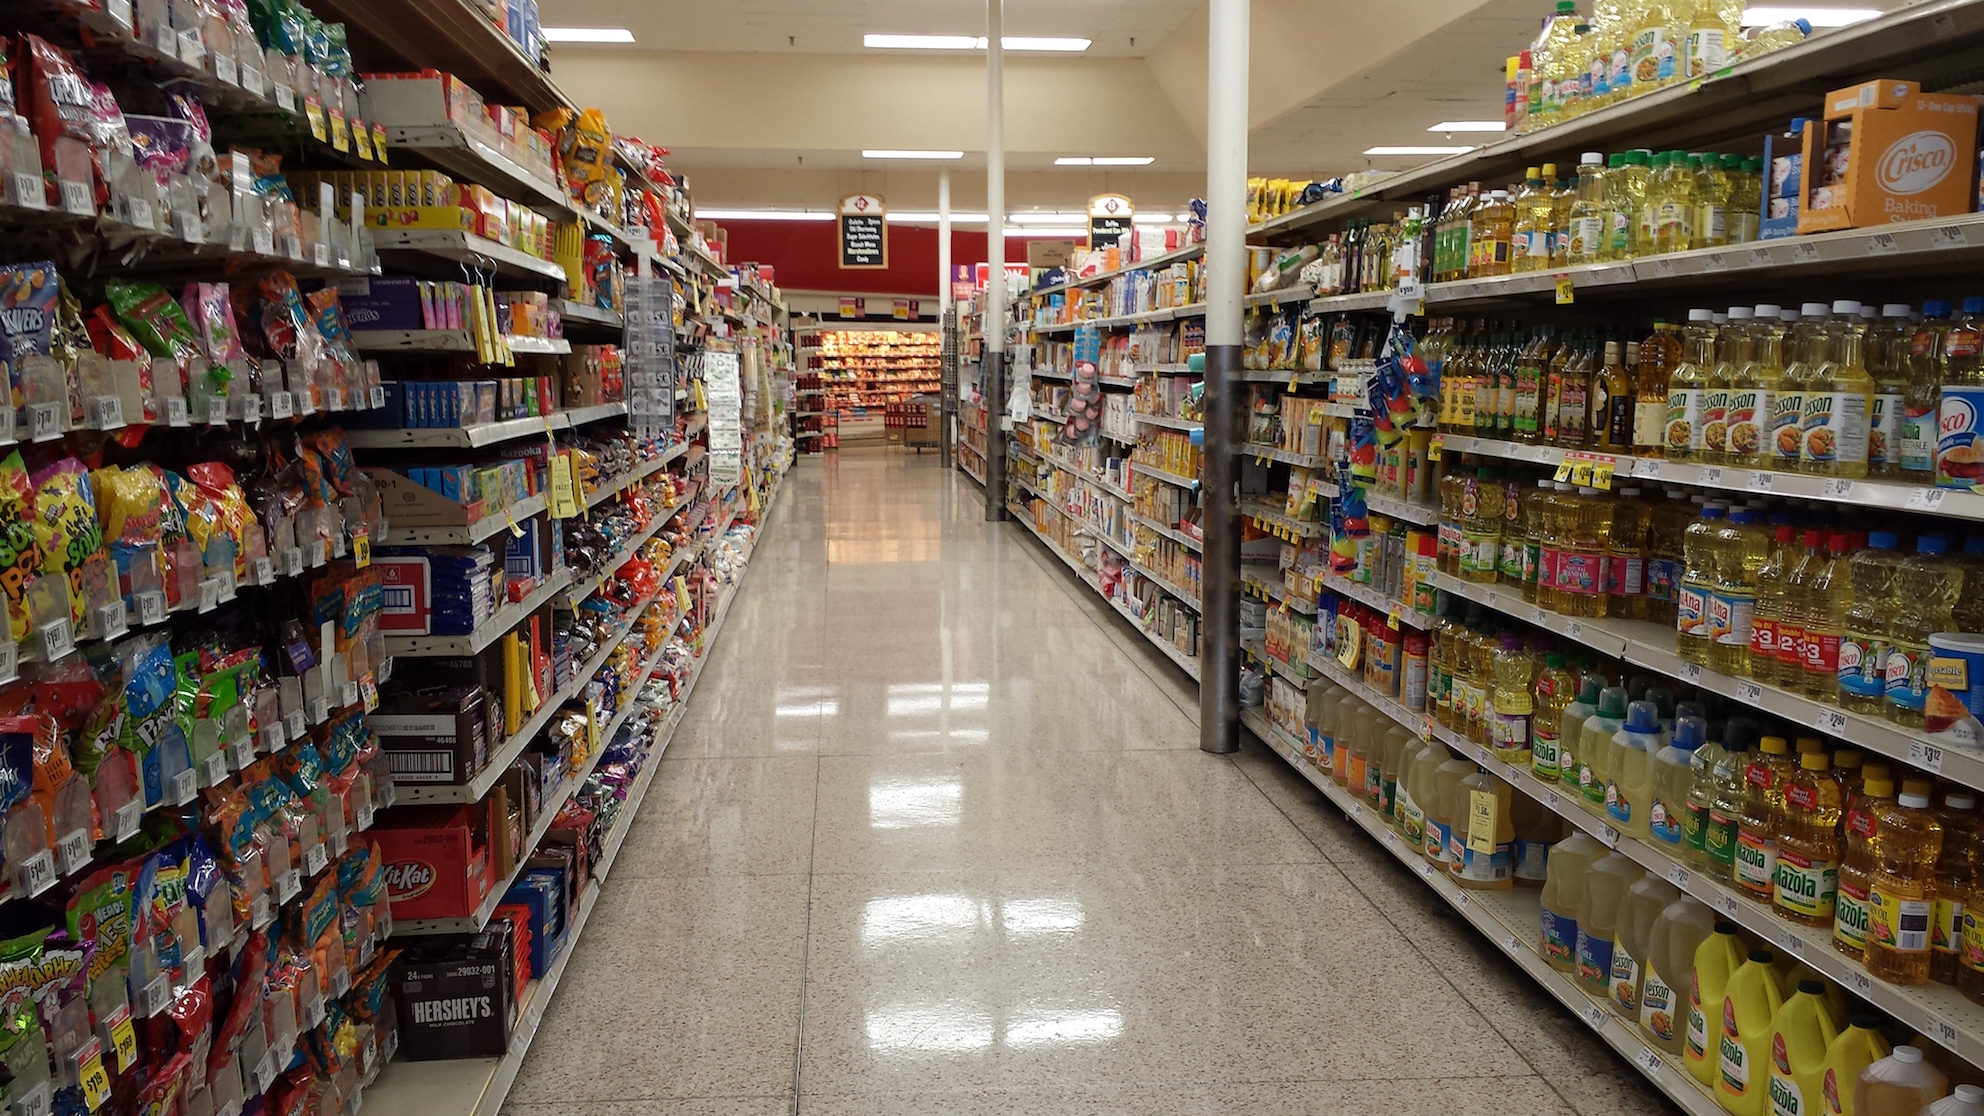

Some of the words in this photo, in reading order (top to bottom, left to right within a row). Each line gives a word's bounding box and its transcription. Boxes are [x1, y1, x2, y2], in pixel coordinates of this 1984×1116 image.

[1884, 147, 1946, 183] Crisco
[1884, 197, 1938, 218] Baking
[1703, 393, 1727, 411] esson
[1729, 393, 1756, 412] esson
[1774, 396, 1801, 416] esson
[1803, 396, 1833, 417] esson
[1940, 412, 1966, 434] sco
[389, 569, 396, 577] 6
[1679, 589, 1701, 612] uAna
[1830, 713, 1846, 728] $294
[1924, 746, 1941, 763] $312
[45, 758, 64, 775] SUGAR
[49, 769, 65, 784] FREE
[1789, 791, 1812, 803] Healthy
[1792, 786, 1809, 797] Heart
[407, 970, 418, 981] 24
[457, 964, 495, 977] 29032-001
[414, 995, 492, 1024] HERSHEY'S
[86, 1070, 104, 1095] $119
